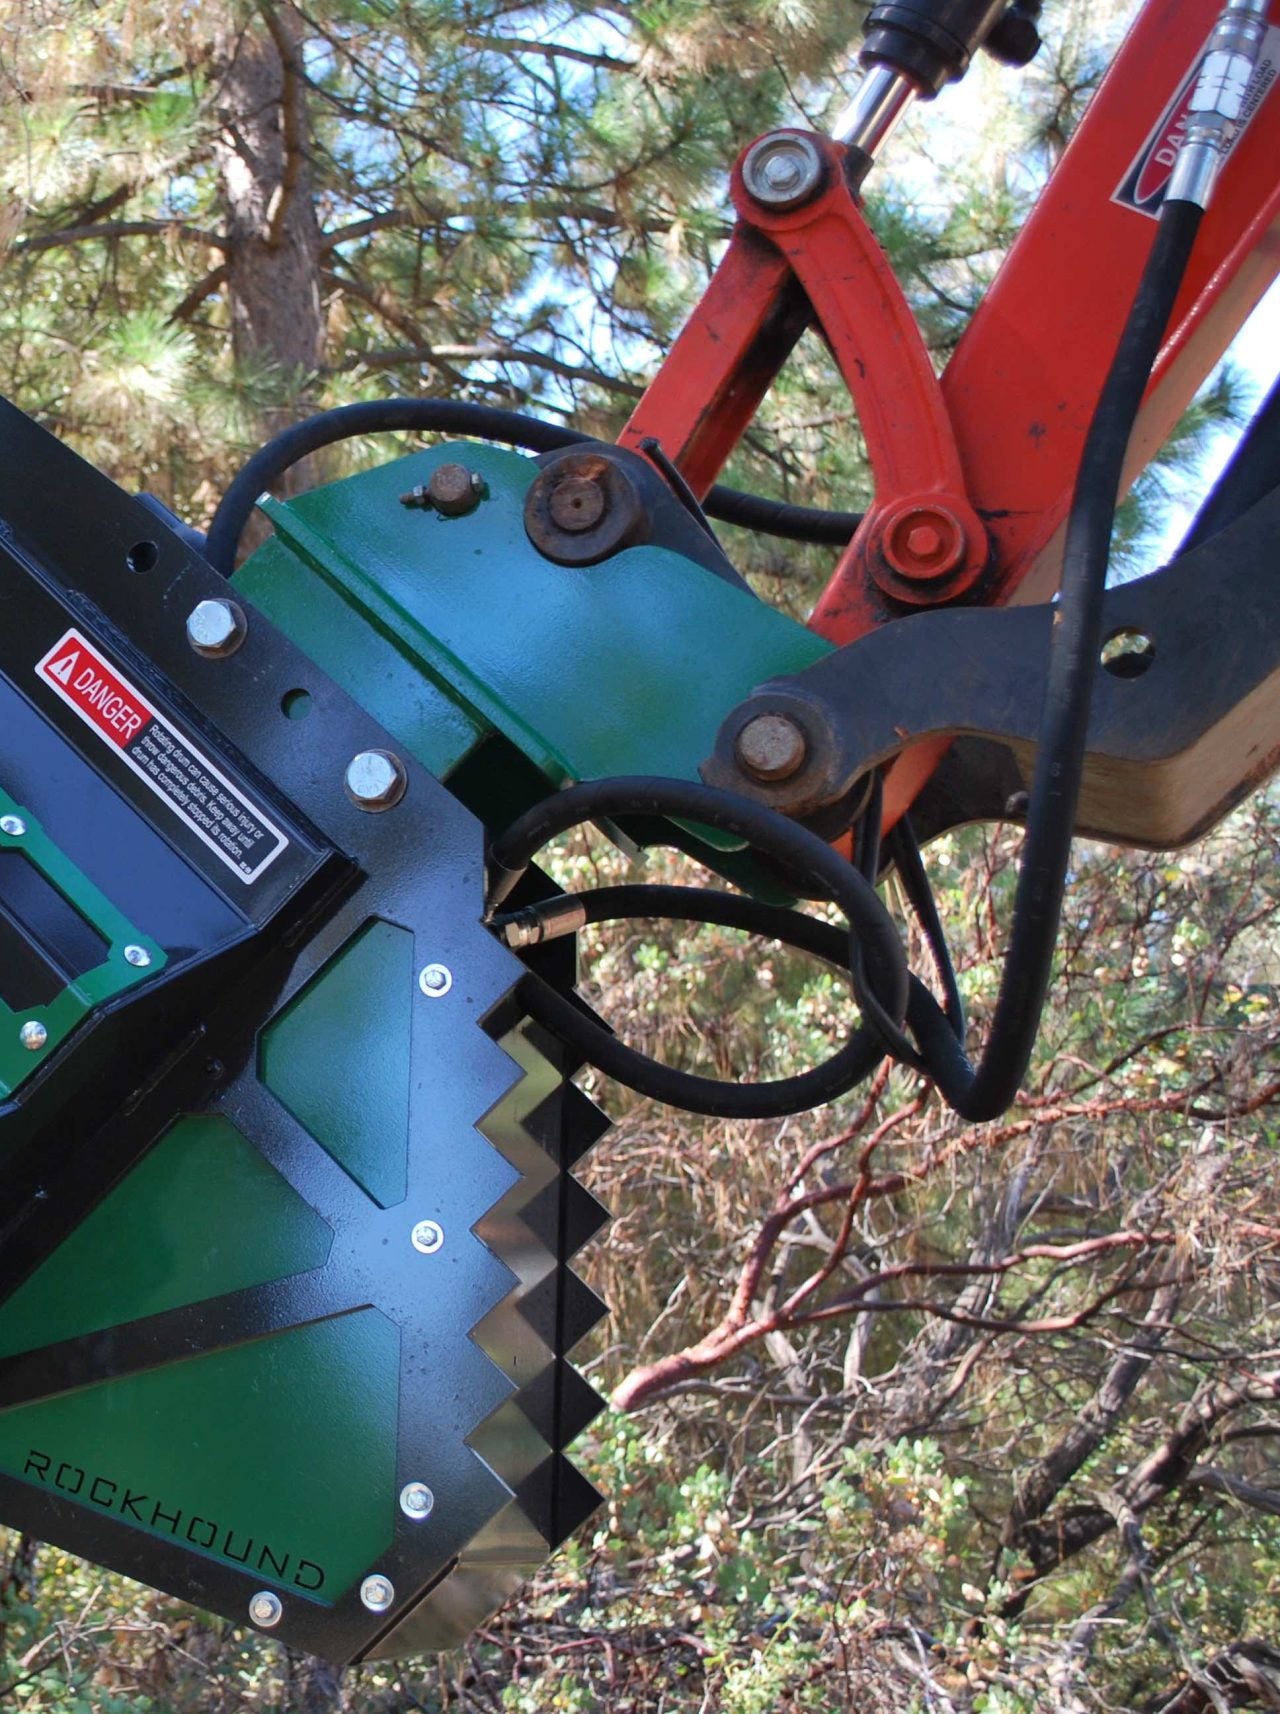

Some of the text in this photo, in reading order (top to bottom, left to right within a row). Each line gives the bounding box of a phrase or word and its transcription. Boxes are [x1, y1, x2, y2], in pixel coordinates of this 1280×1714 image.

[73, 667, 142, 739] DANGER
[131, 746, 149, 764] drum
[146, 759, 160, 775] has
[157, 772, 190, 806] completely
[187, 802, 214, 828] stopped
[140, 735, 160, 755] throw
[157, 752, 189, 785] dangerous
[205, 799, 224, 820] Keep
[221, 817, 240, 836] away
[237, 832, 254, 848] until
[148, 724, 264, 839] Rotating drum can cause serious injury or
[23, 1449, 326, 1591] ROCKHOUND
